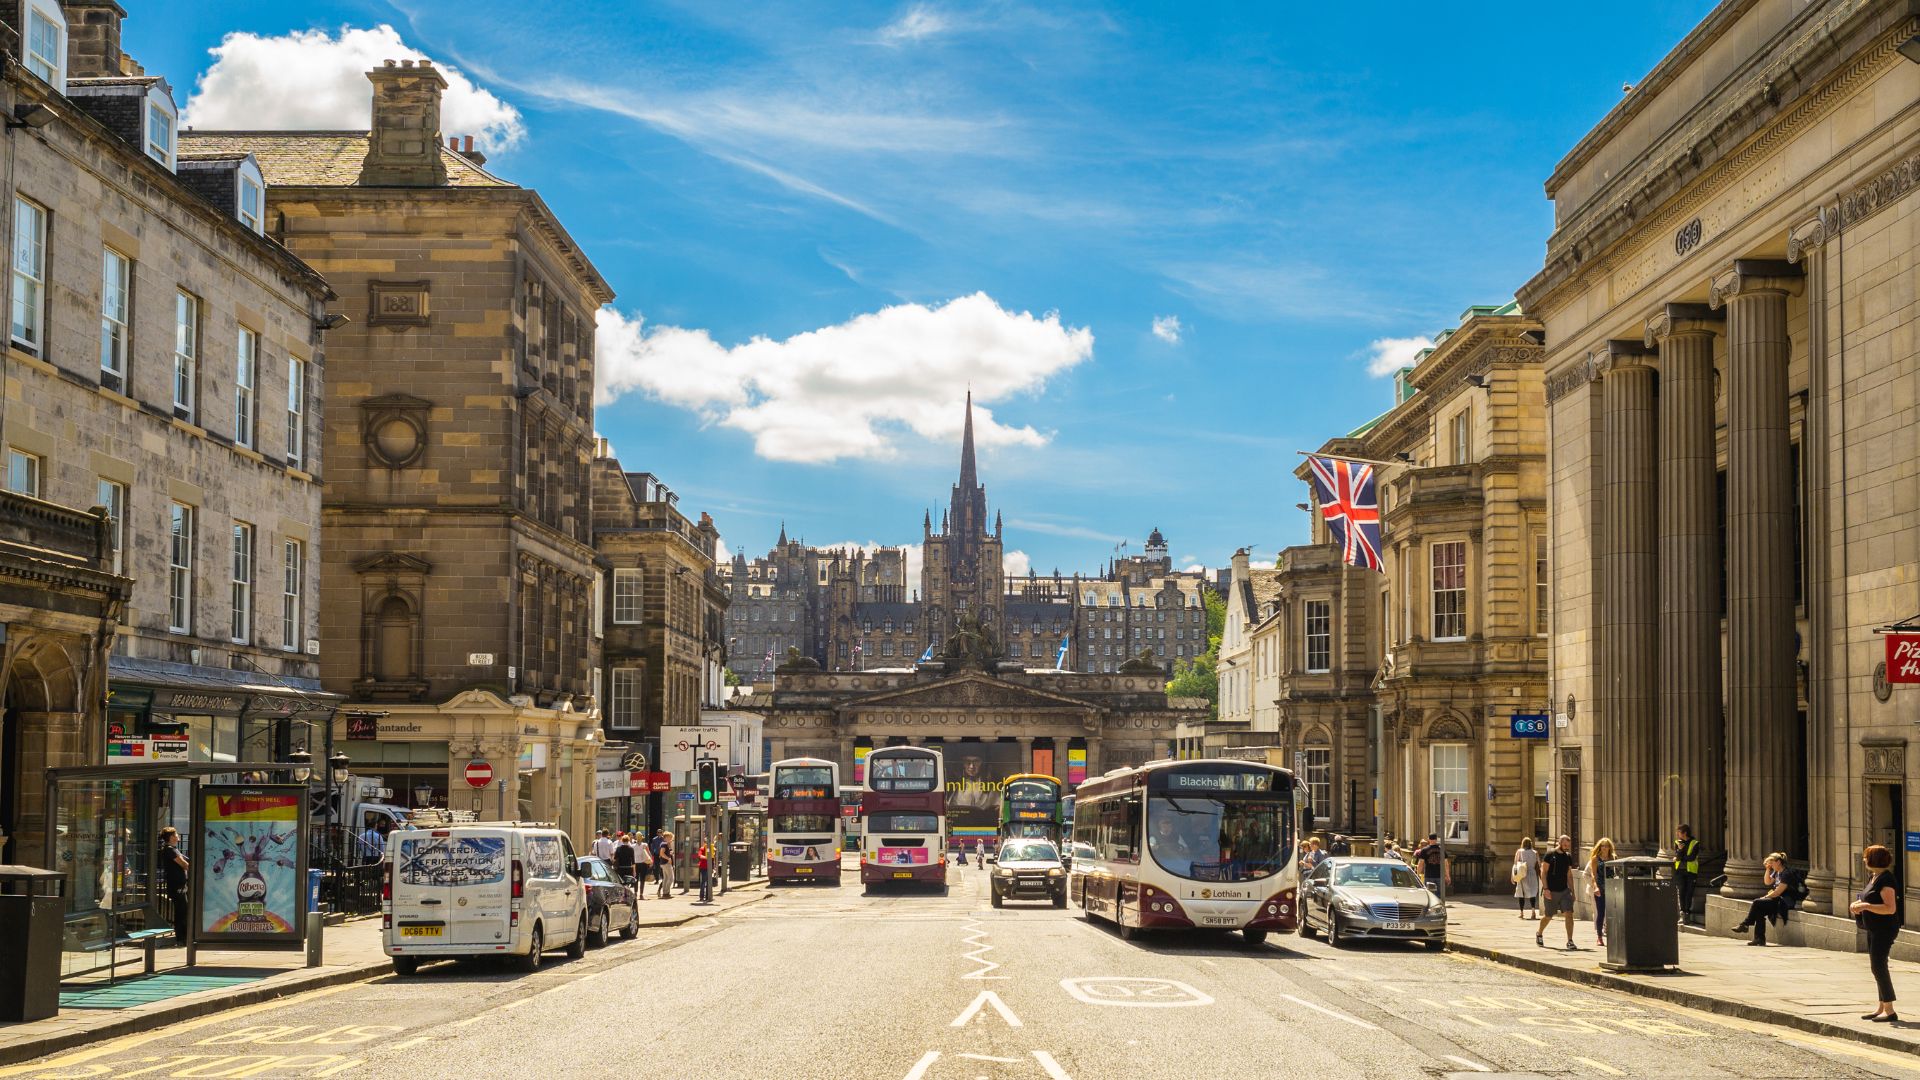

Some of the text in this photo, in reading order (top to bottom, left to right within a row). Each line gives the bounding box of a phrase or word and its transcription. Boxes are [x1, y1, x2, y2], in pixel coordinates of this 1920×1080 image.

[383, 296, 415, 312] 1881
[1894, 641, 1920, 660] Piz
[1900, 660, 1920, 677] Hu
[208, 697, 231, 709] HOUSE
[375, 722, 422, 732] Santander
[1517, 721, 1545, 731] TSB
[947, 777, 1007, 793] mbrand
[1180, 775, 1265, 790] Blackhall 42
[412, 858, 493, 866] REFRIGERATION
[239, 880, 265, 892] Ribena
[1213, 889, 1242, 898] Lothian
[425, 927, 439, 935] TTV
[191, 1025, 403, 1045] BUS
